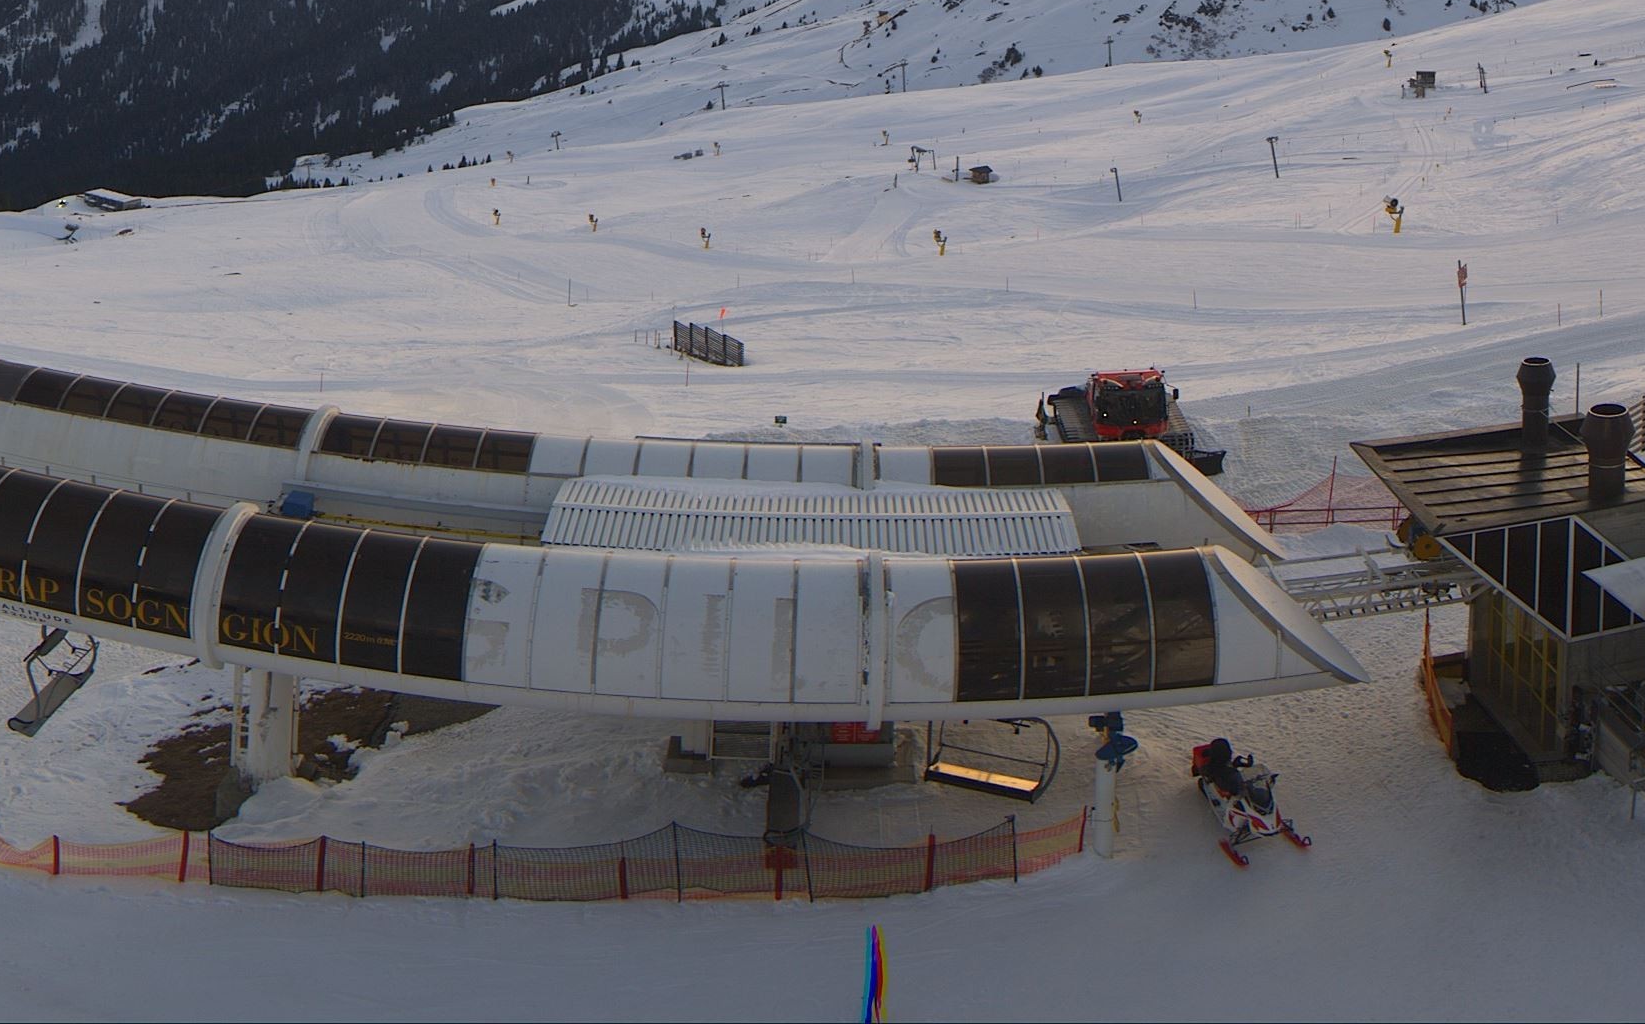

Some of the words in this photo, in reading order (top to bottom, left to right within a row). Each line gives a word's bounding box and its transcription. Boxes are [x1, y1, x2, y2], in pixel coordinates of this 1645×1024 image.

[1, 603, 73, 625] ALTITUDE
[85, 588, 190, 632] SOGN
[222, 613, 319, 654] GION
